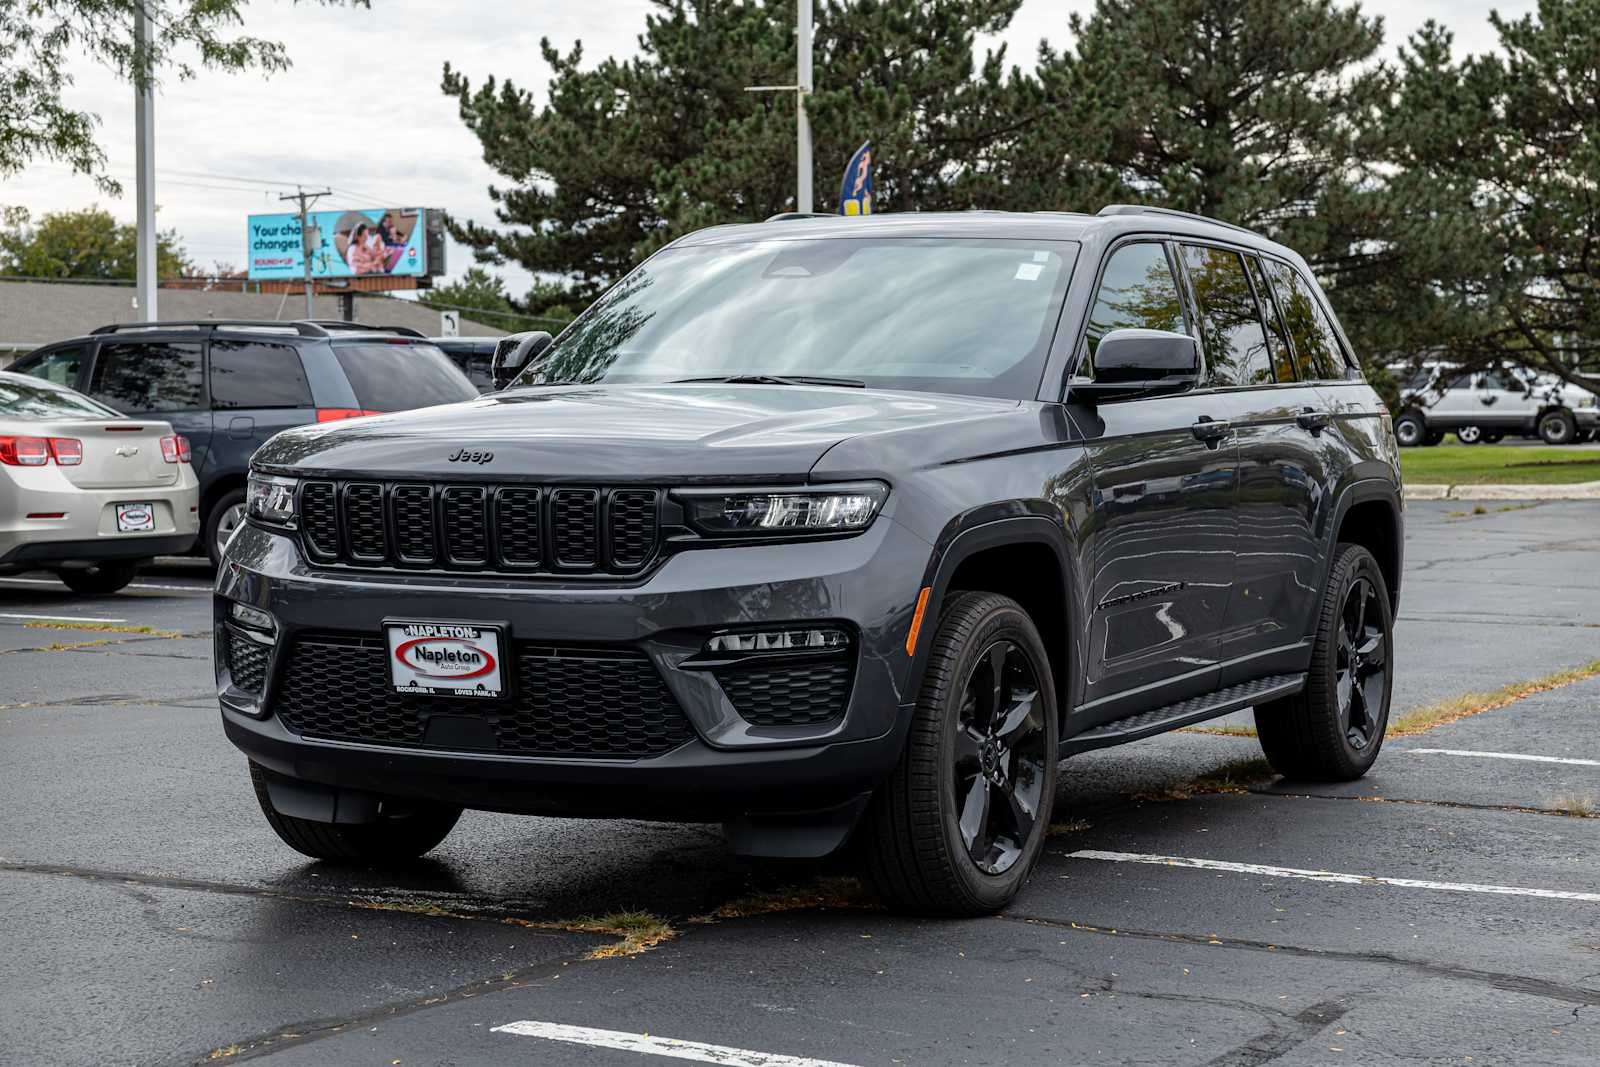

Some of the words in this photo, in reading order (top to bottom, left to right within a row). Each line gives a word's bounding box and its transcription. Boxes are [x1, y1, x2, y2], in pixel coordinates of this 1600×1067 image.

[253, 224, 278, 237] Your
[253, 238, 300, 252] changes
[448, 448, 494, 465] Jeep
[408, 625, 473, 638] NAPLETON
[414, 645, 480, 665] Napleton
